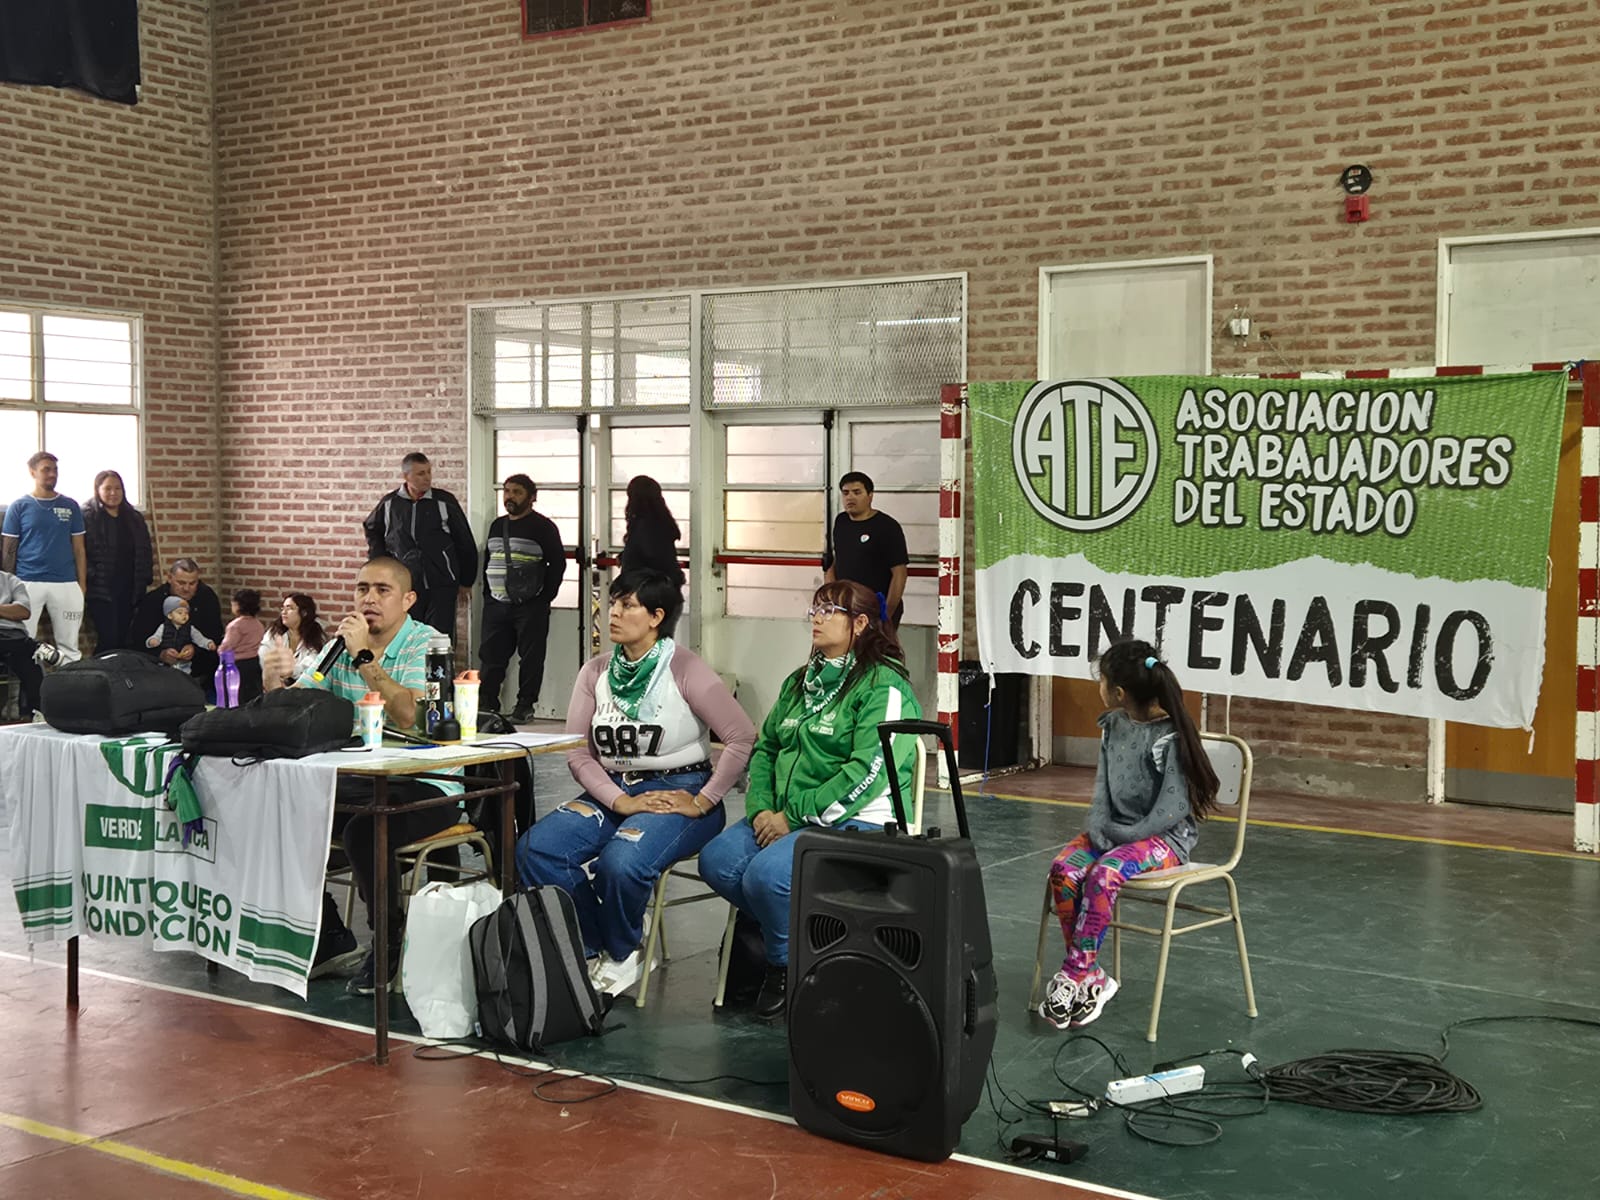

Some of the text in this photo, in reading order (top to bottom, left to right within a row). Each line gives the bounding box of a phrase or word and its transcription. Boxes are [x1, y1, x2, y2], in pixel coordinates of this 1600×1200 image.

[1175, 389, 1434, 433] ASOCIACION
[1025, 385, 1141, 516] ATE
[1176, 434, 1512, 486] TRABAJADORES
[1174, 479, 1414, 535] DEL ESTADO
[1009, 578, 1495, 701] CENTENARIO
[594, 724, 665, 757] 987
